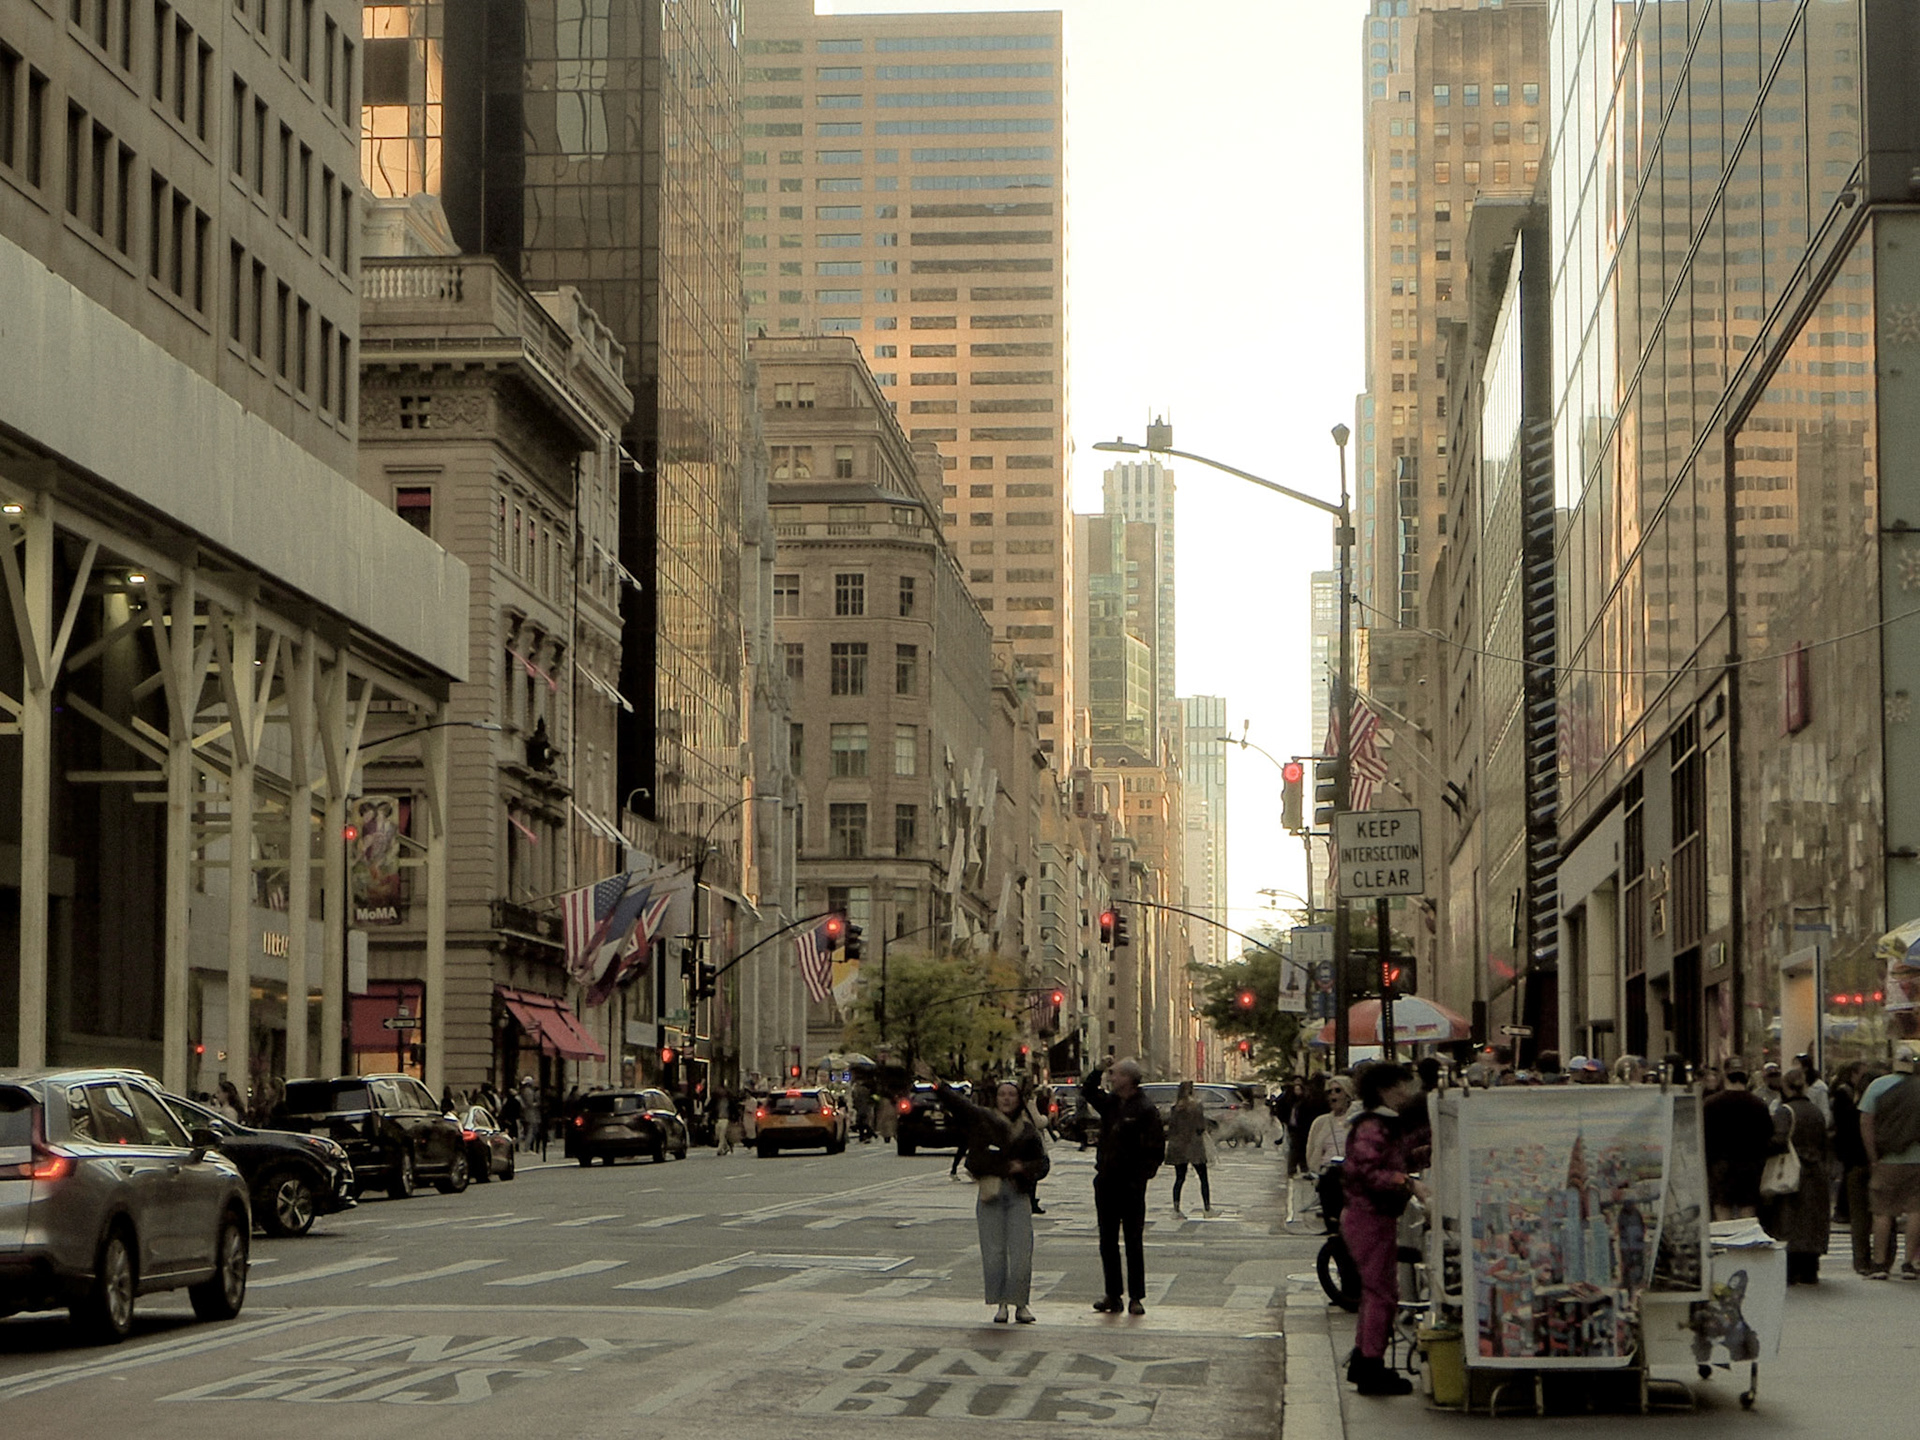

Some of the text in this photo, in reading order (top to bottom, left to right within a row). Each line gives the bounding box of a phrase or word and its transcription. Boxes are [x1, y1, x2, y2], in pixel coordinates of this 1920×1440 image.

[1357, 820, 1401, 838] KEEP
[1341, 844, 1420, 863] INTERSECTION
[1353, 869, 1410, 888] CLEAR
[356, 906, 398, 921] MoMA
[249, 1336, 662, 1362] ONLY
[806, 1347, 1209, 1381] ONLY
[155, 1366, 552, 1405] BUS
[799, 1378, 1160, 1426] BUS
